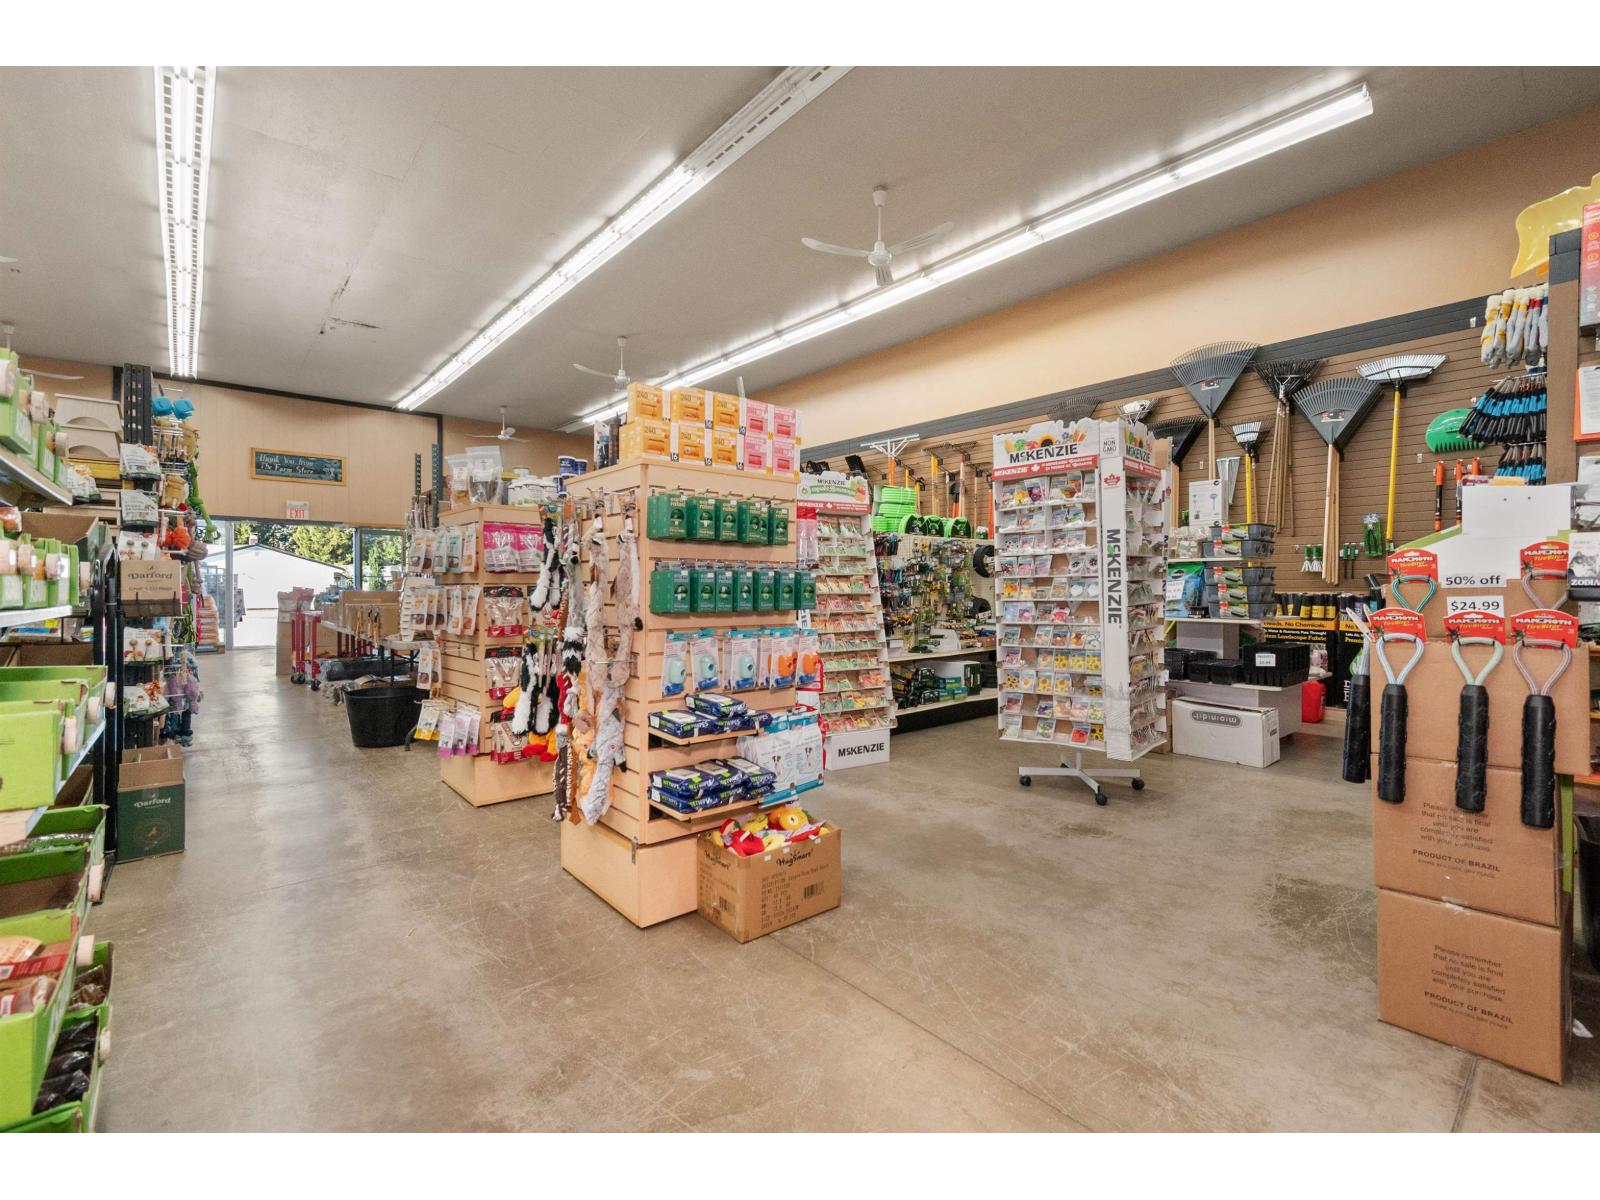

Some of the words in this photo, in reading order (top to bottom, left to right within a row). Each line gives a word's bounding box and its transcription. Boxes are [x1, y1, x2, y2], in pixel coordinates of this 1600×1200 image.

[274, 464, 293, 472] Farm
[296, 466, 314, 474] Store
[290, 508, 304, 518] EXIT
[128, 571, 172, 580] Darford
[1446, 576, 1476, 586] 50%
[1480, 574, 1501, 584] off
[1451, 600, 1500, 612] $24.99
[134, 798, 172, 808] Darford
[1474, 819, 1490, 827] final
[1412, 849, 1452, 861] PRODUCT
[1468, 860, 1500, 872] BRAZIL
[1435, 944, 1460, 957] Please
[1462, 954, 1502, 968] remember
[1446, 965, 1460, 973] until
[1460, 961, 1476, 970] sale
[1487, 968, 1504, 977] final
[1432, 969, 1471, 985] completely
[1472, 981, 1506, 995] satisfied
[1424, 991, 1464, 1007] PRODUCT
[1481, 1009, 1514, 1024] BRAZIL
